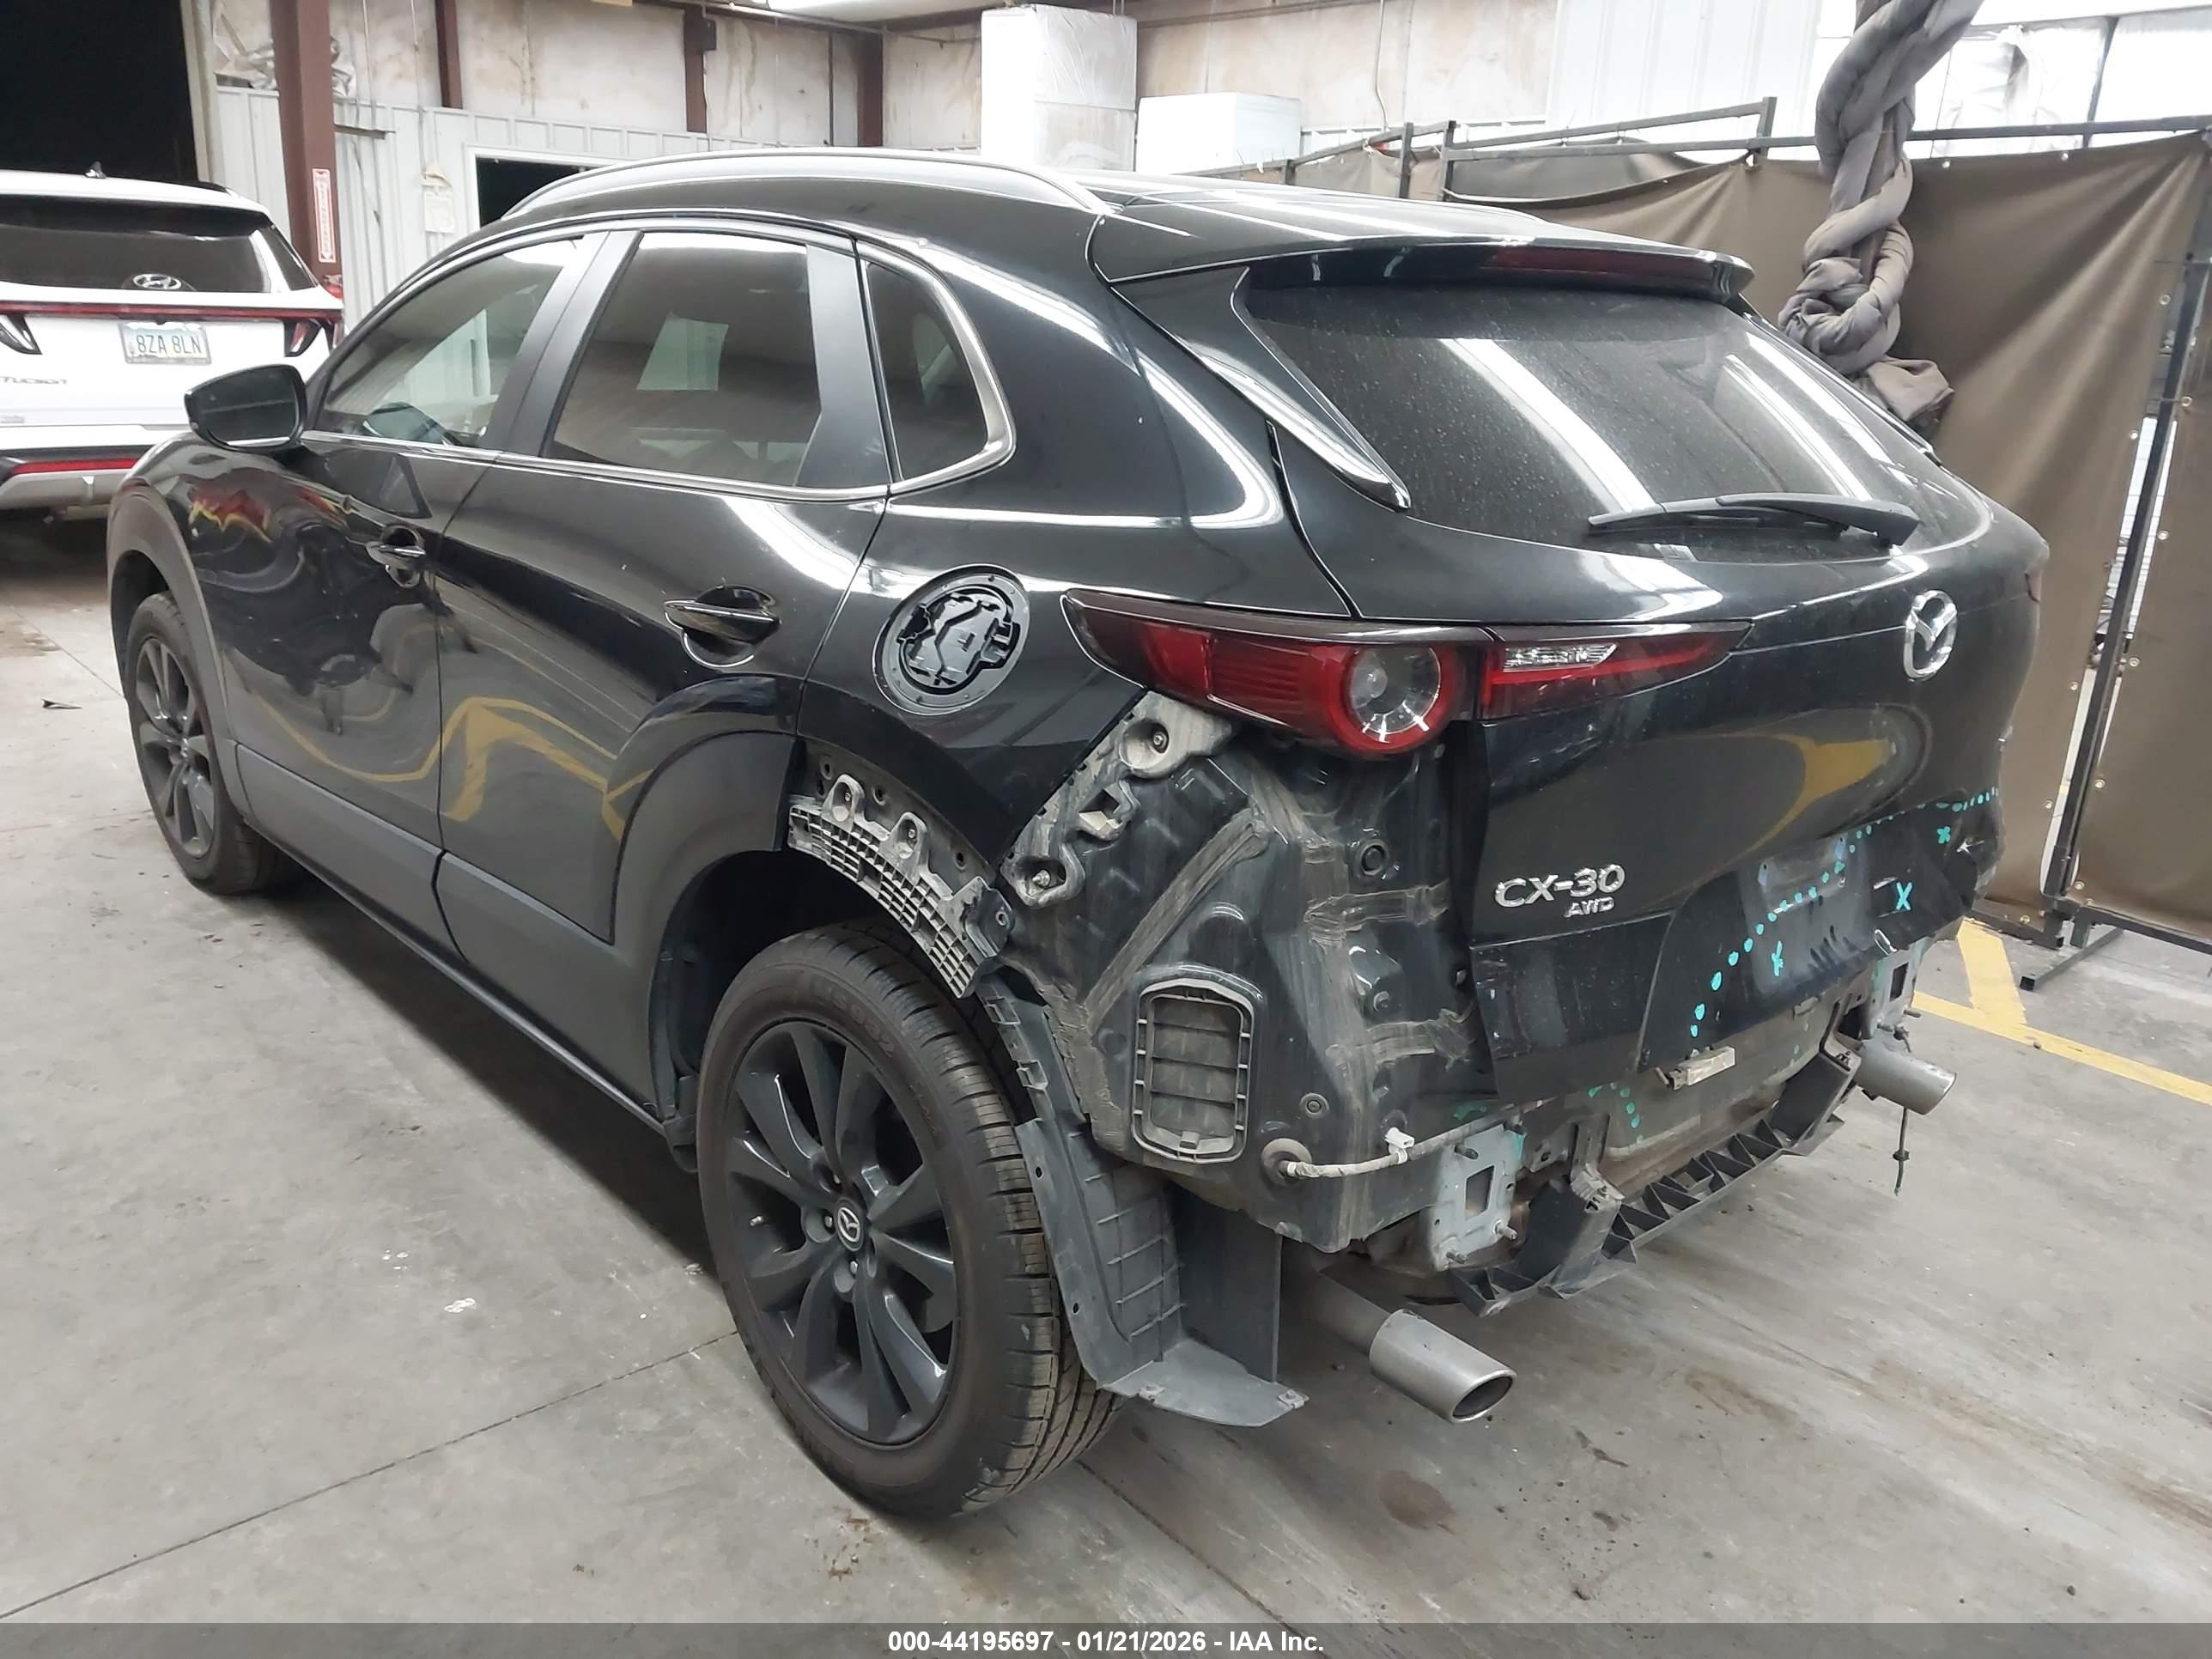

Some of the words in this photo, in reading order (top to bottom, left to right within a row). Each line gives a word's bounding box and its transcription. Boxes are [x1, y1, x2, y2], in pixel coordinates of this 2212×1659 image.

[137, 334, 167, 354] 8ZA
[172, 335, 202, 354] 8LN
[1494, 863, 1626, 908] CX-30
[1563, 896, 1615, 918] AWD
